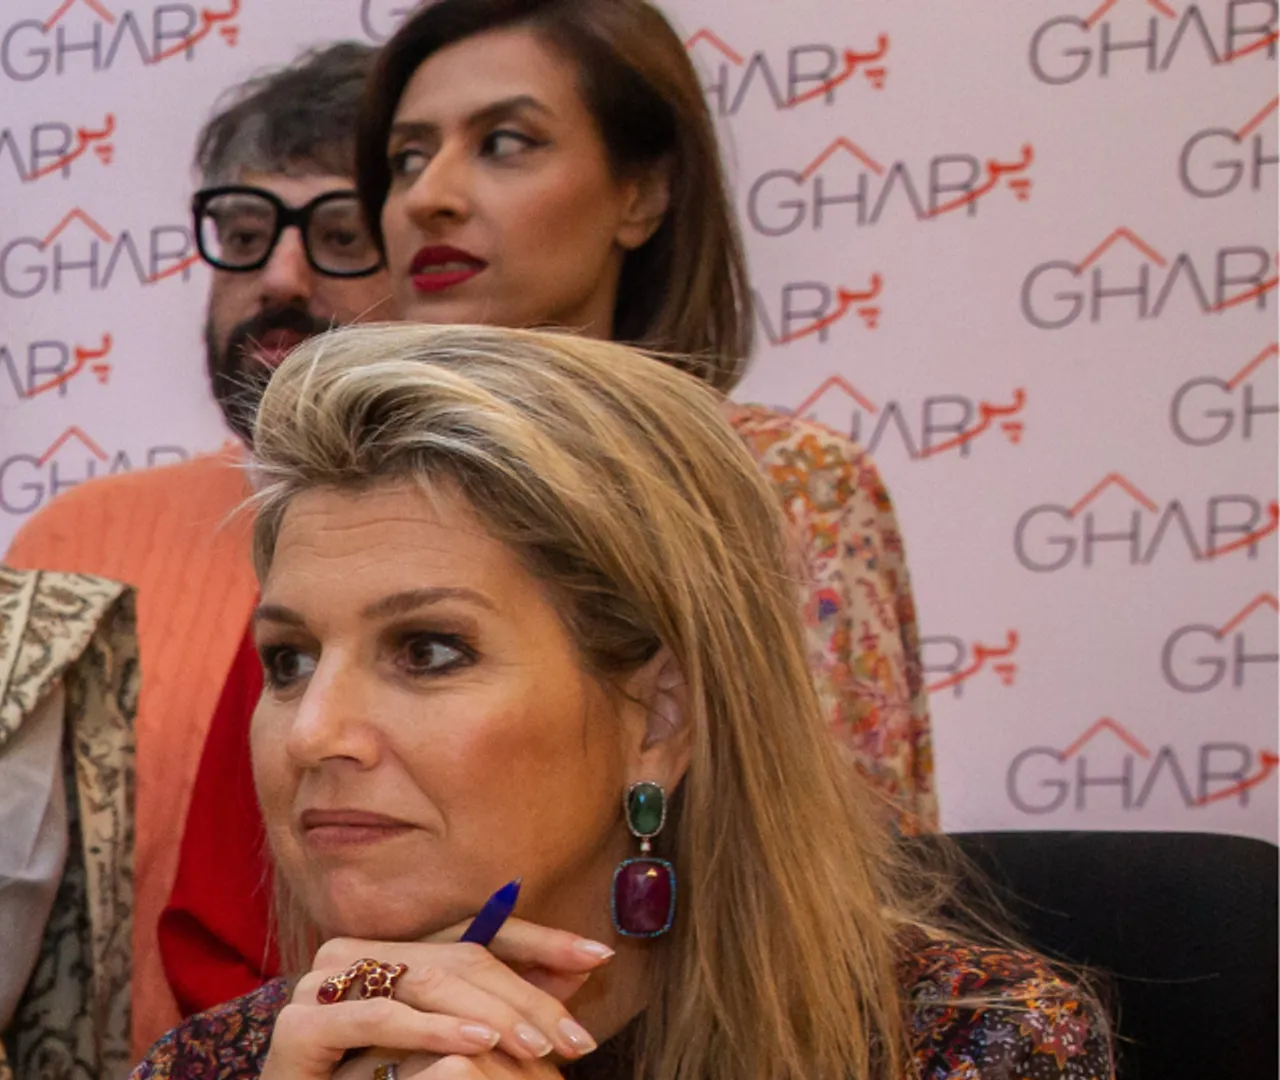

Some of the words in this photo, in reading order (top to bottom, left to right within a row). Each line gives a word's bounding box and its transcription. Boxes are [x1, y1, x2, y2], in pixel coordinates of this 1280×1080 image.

[747, 154, 981, 237] GHAR
[1014, 494, 1262, 572] GHAR
[1006, 742, 1252, 815] GHAR
